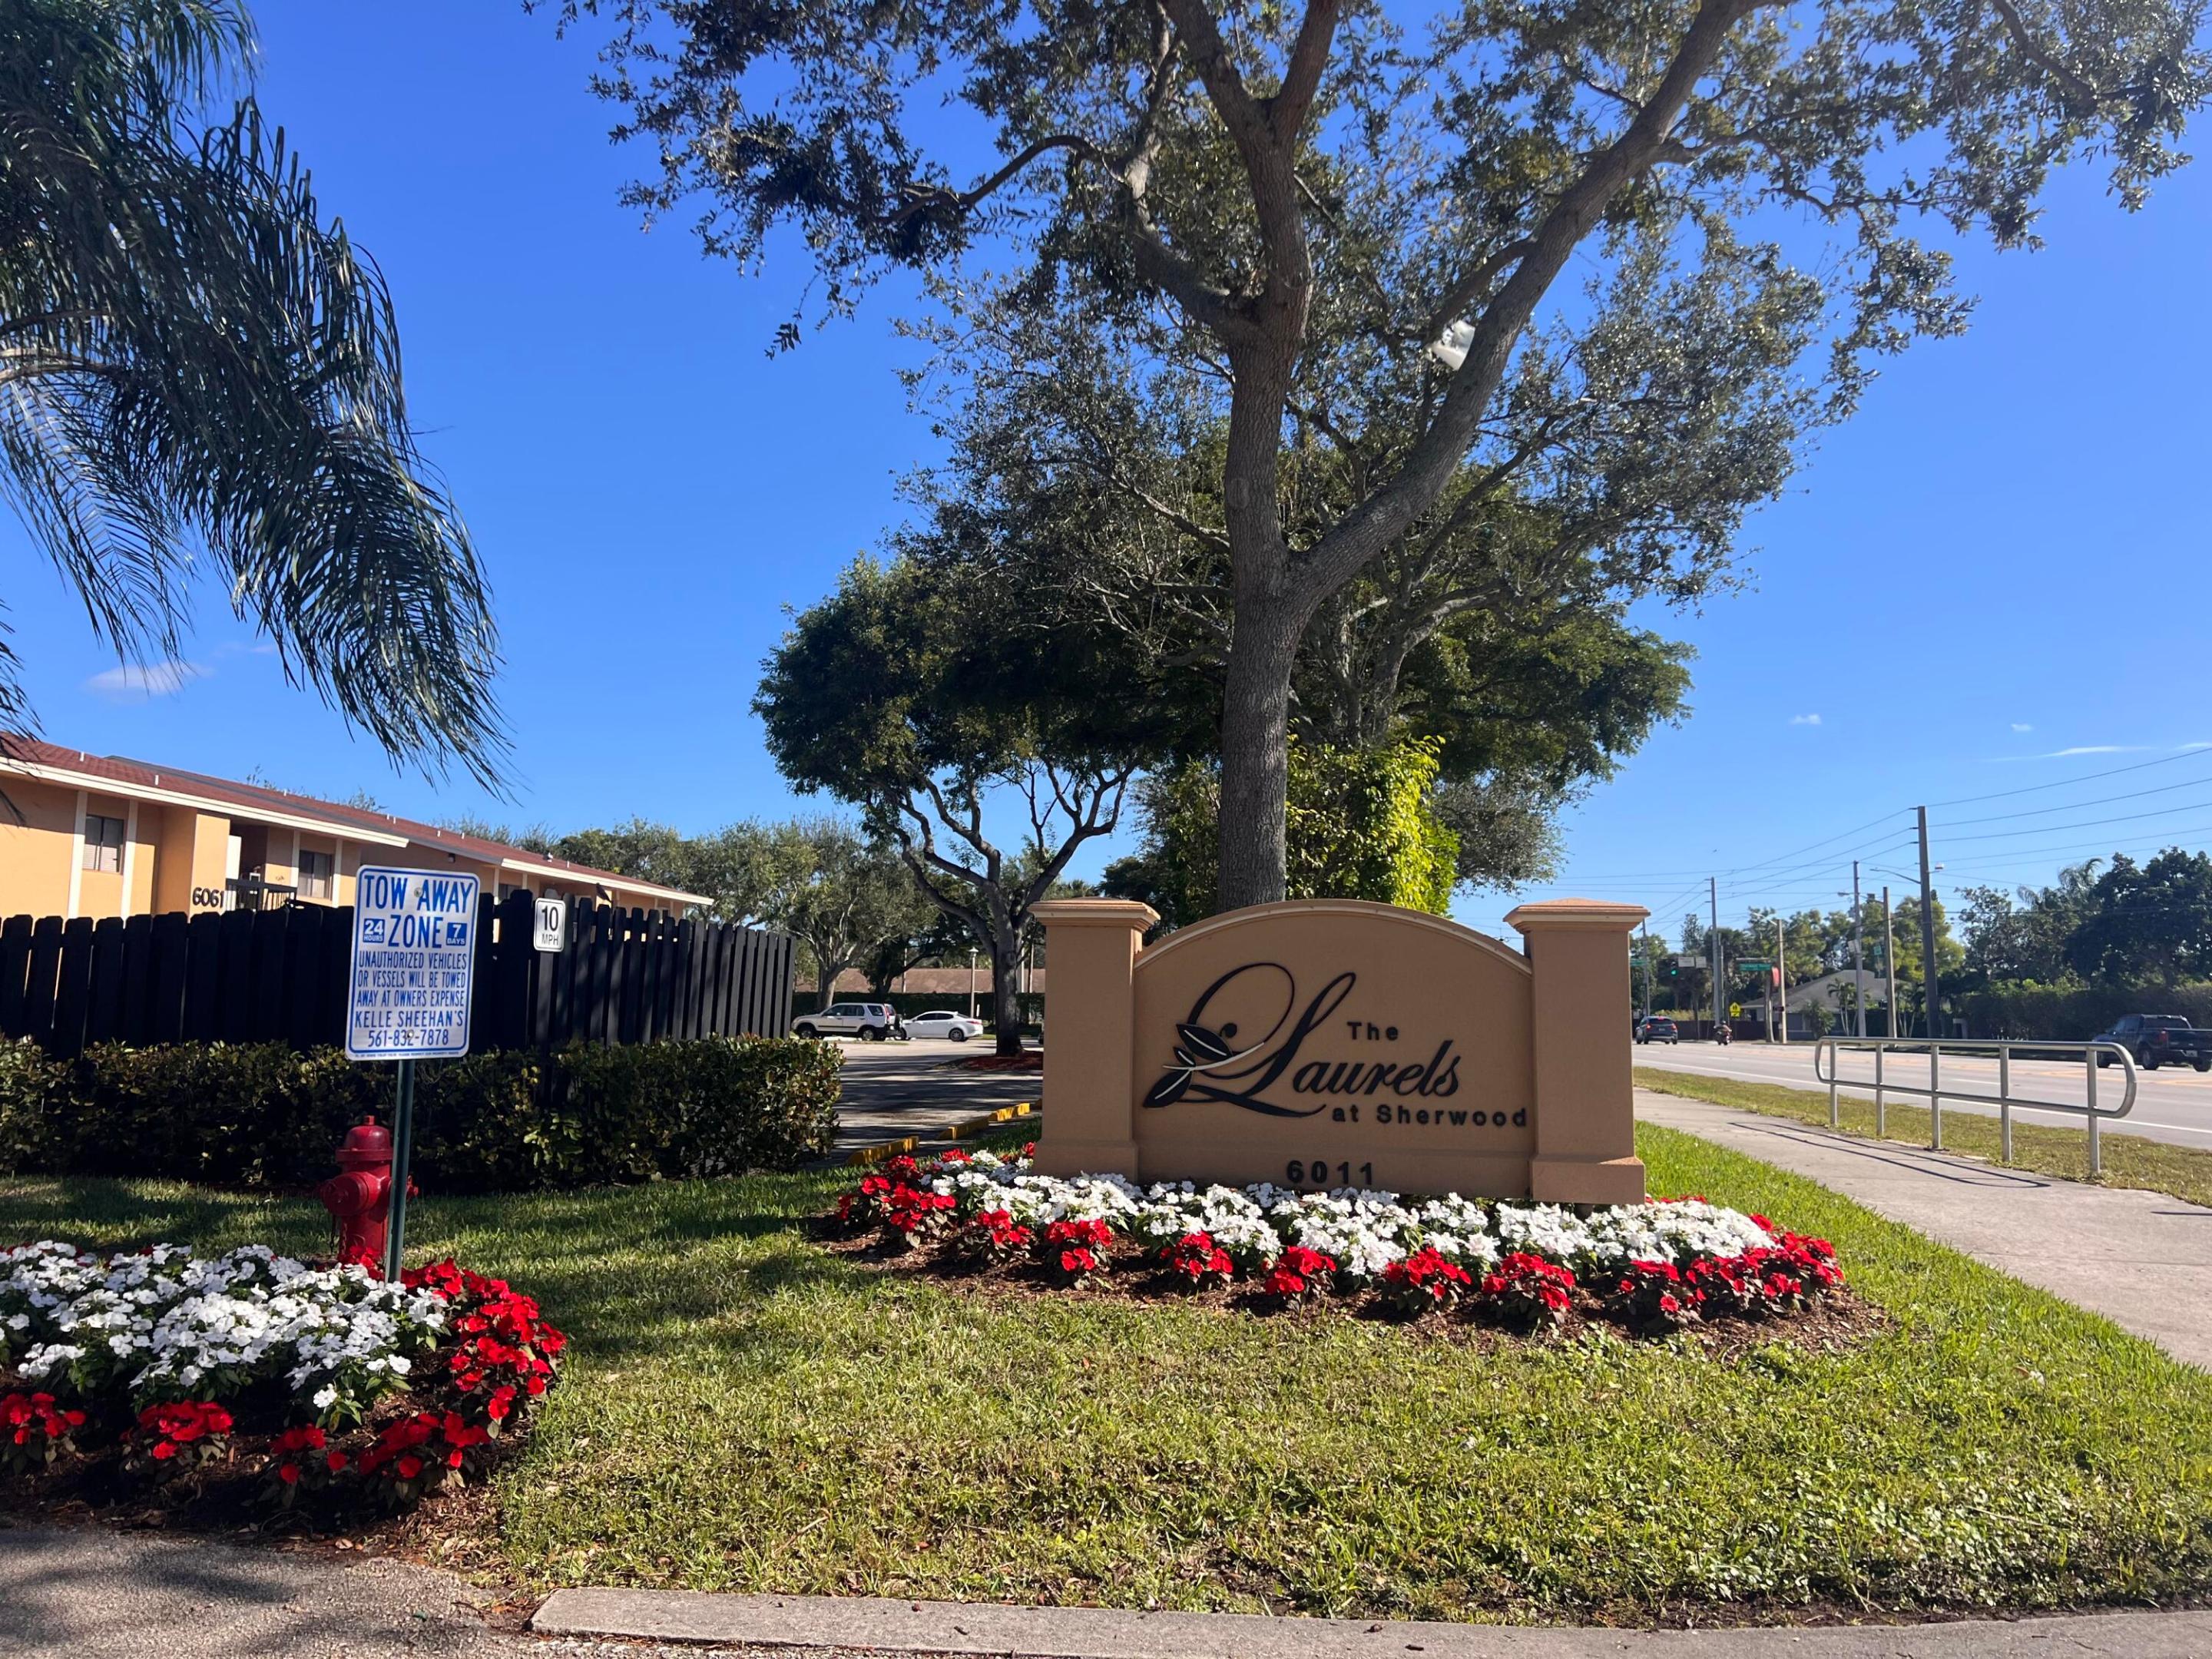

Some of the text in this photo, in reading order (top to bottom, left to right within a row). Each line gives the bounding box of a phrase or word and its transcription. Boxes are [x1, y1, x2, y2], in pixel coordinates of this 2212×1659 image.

[192, 886, 224, 908] 6061
[364, 875, 473, 913] TOW AWAY
[364, 919, 384, 935] 24
[541, 906, 559, 931] 10
[388, 914, 443, 949] ZONE
[452, 924, 462, 938] 7
[541, 933, 560, 945] MPH
[359, 951, 467, 969] UNAUTHORIZED VEHICLES
[357, 970, 466, 988] OR VESSELS WILL BE TOWED
[356, 990, 465, 1007] AWAY AT OWNERS EXPENSE
[355, 1010, 464, 1028] KELLE SHEEHAN'S
[1178, 962, 1462, 1118] Laurels
[1346, 1021, 1399, 1041] The
[1331, 1105, 1528, 1128] at Sherwood
[1286, 1160, 1374, 1187] 6011
